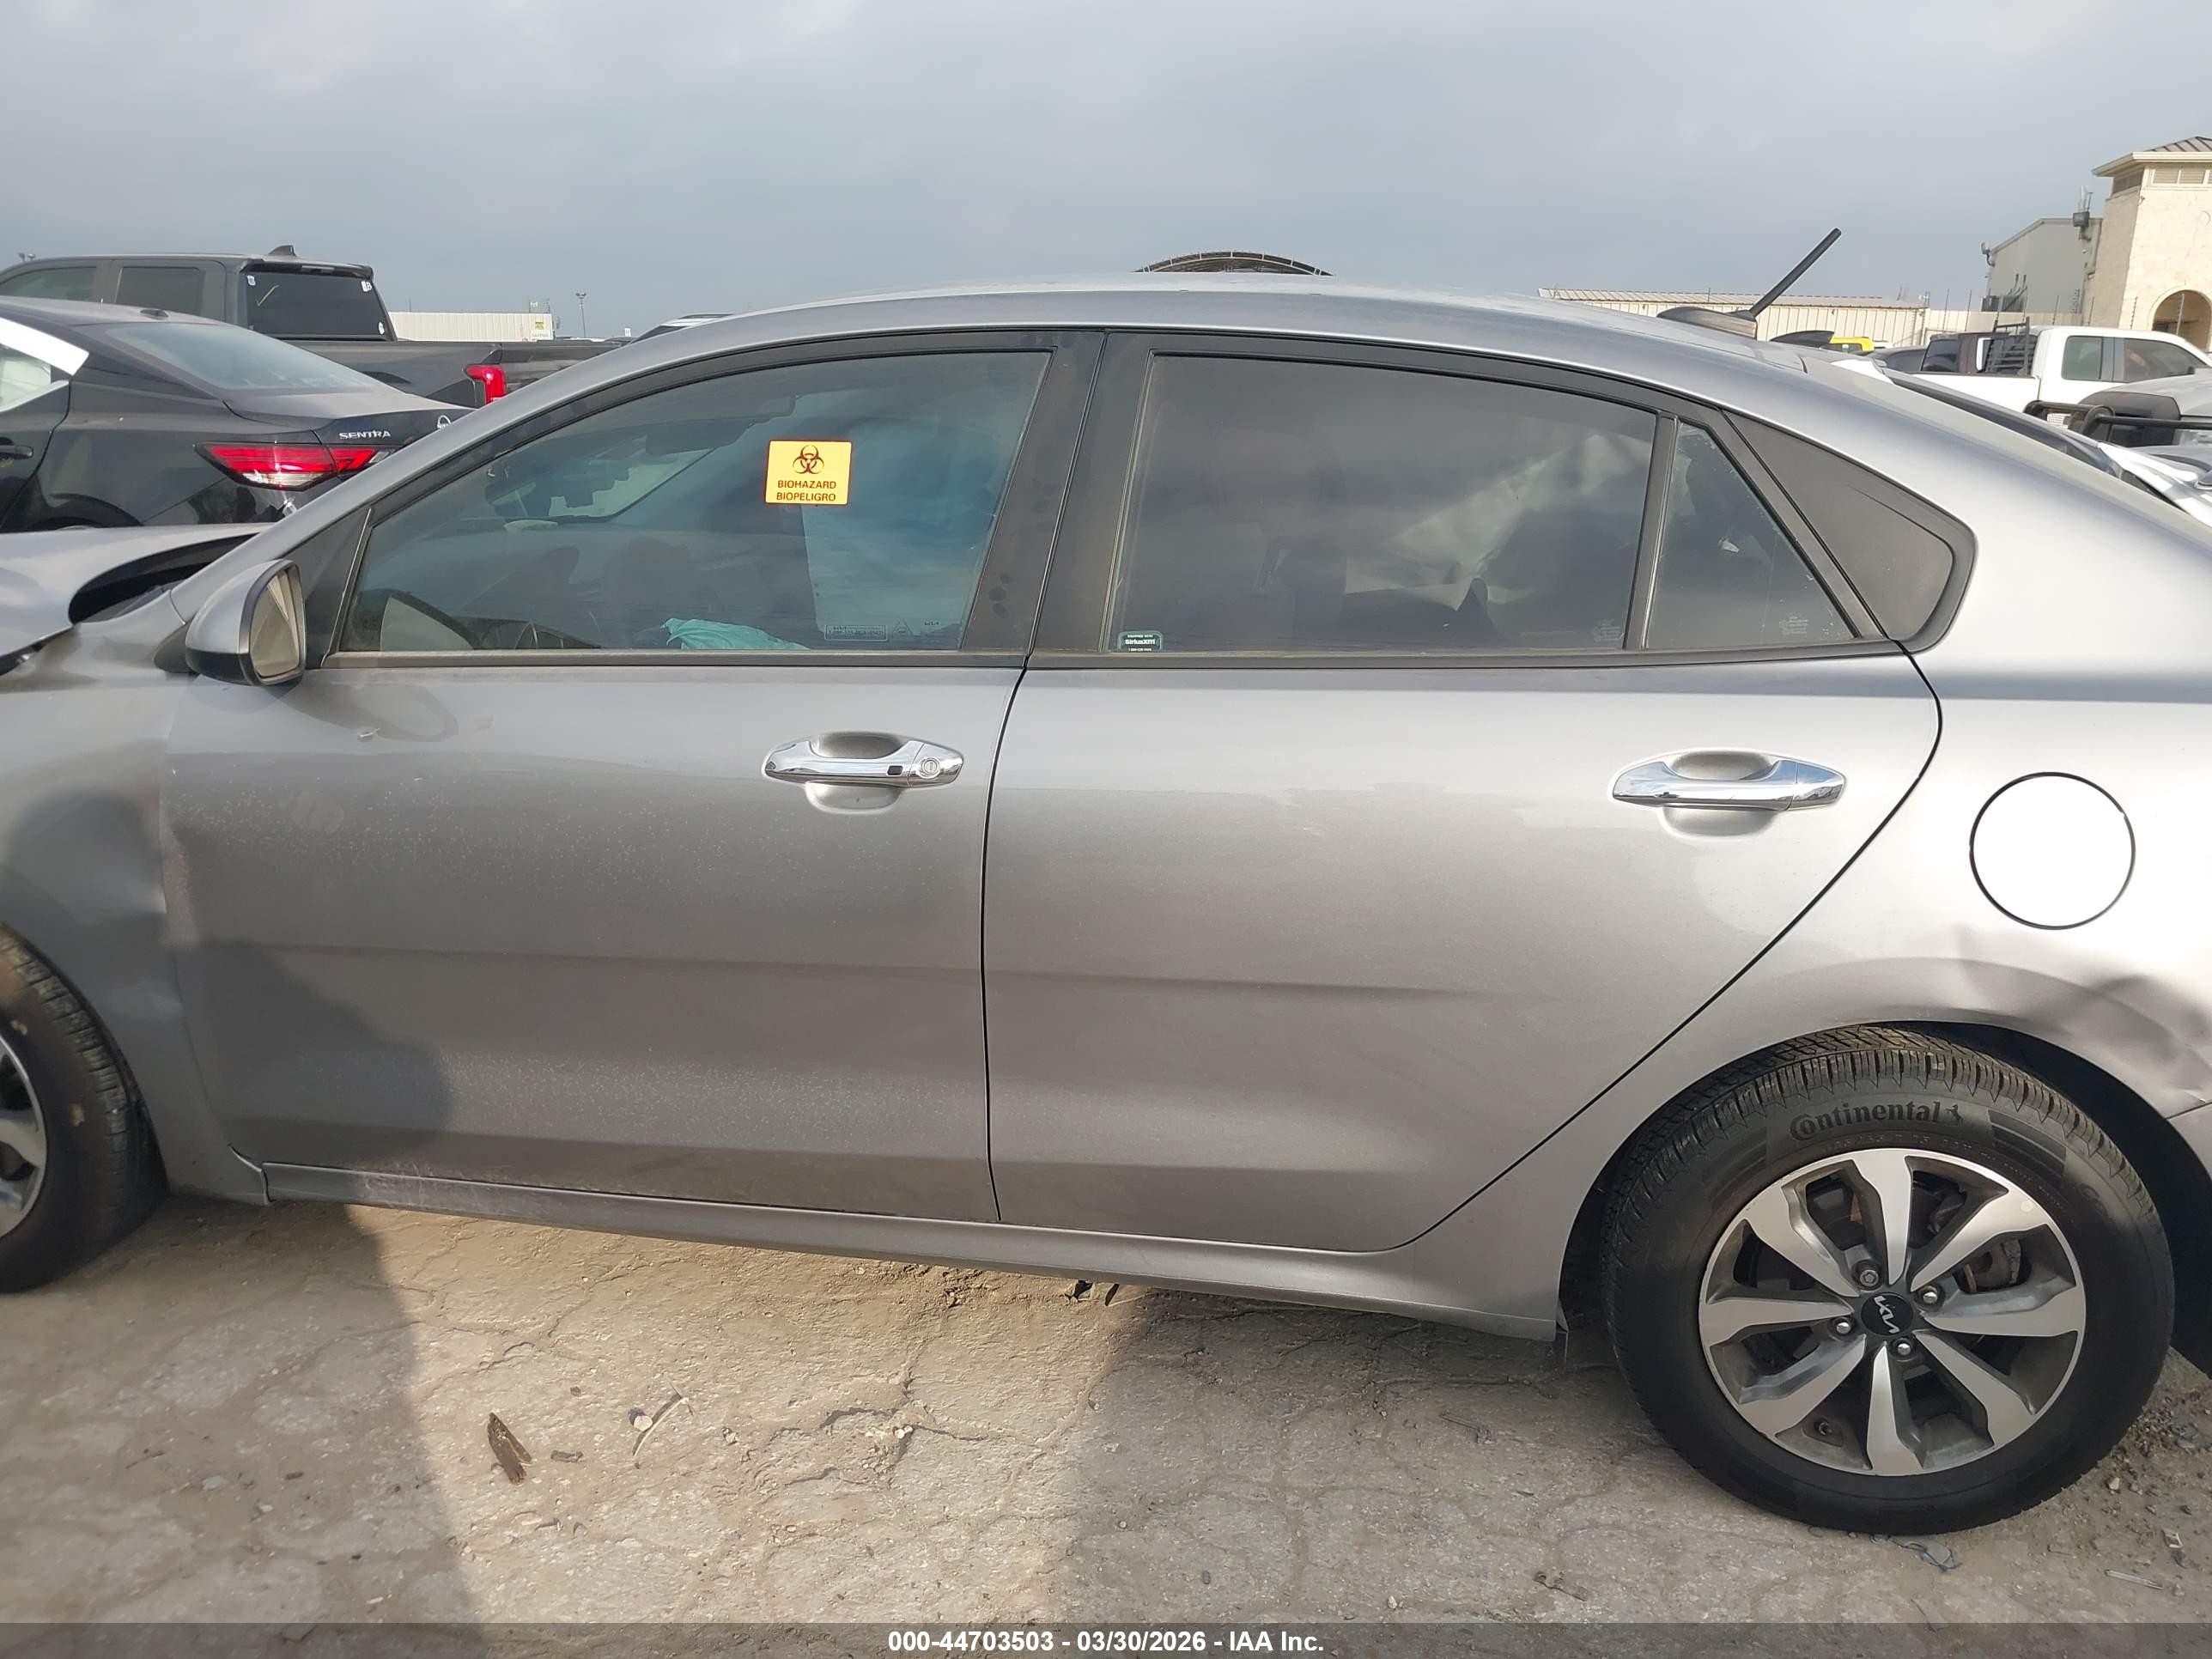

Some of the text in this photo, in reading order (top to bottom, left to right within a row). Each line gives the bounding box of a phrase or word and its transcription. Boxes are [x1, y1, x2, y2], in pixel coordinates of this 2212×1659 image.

[339, 430, 391, 440] SENTRA
[777, 480, 836, 489] BIOHAZARD
[776, 492, 836, 501] BIOPELIGRO
[1790, 1101, 1942, 1142] Continental
